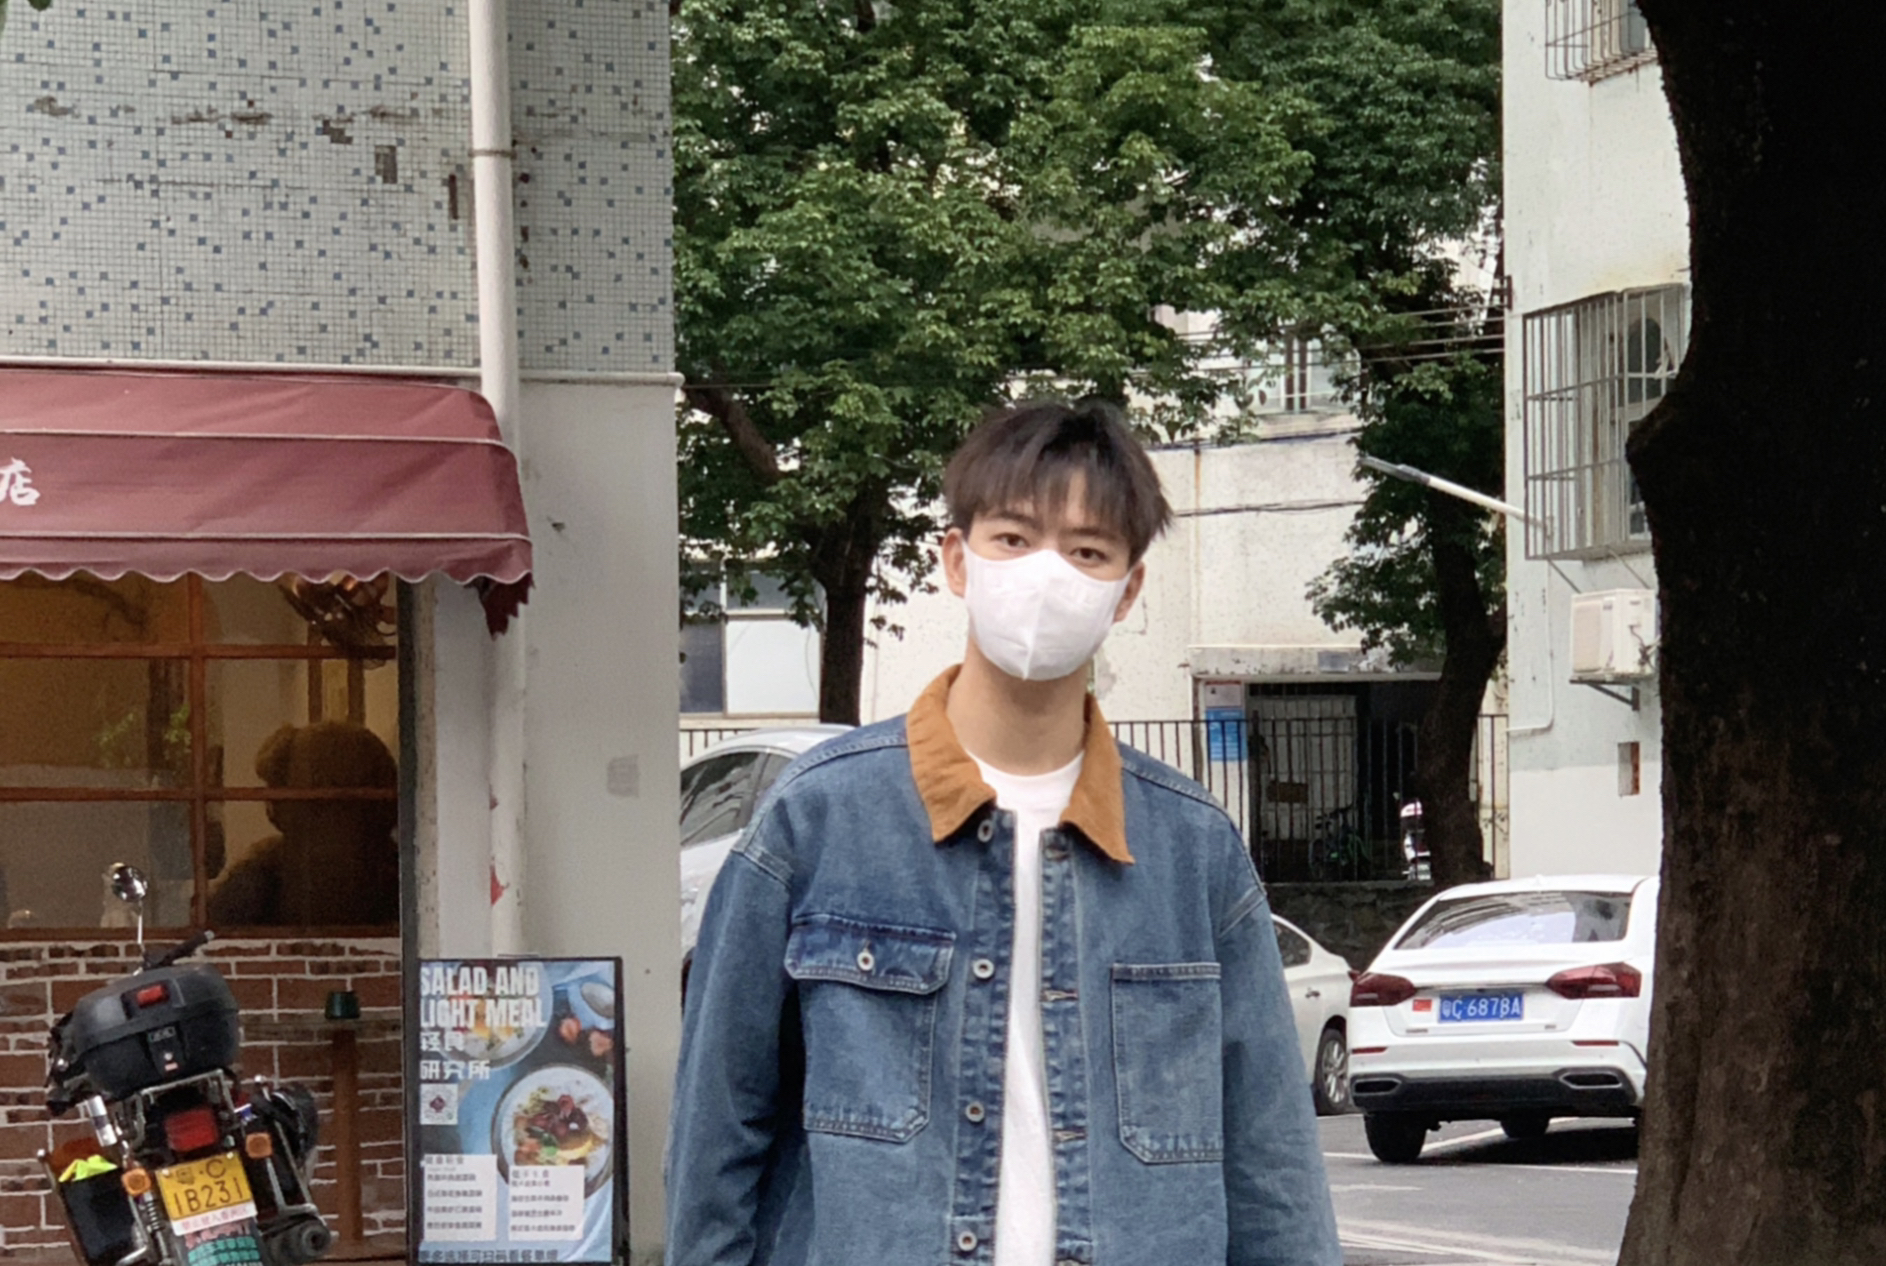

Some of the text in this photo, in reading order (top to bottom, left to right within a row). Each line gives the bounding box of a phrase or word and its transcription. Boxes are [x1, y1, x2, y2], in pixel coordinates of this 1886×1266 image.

[0, 457, 41, 506] 店
[420, 966, 540, 996] SALAD AND
[420, 998, 547, 1028] LIGHT MEAL
[420, 1060, 490, 1080] 研究所
